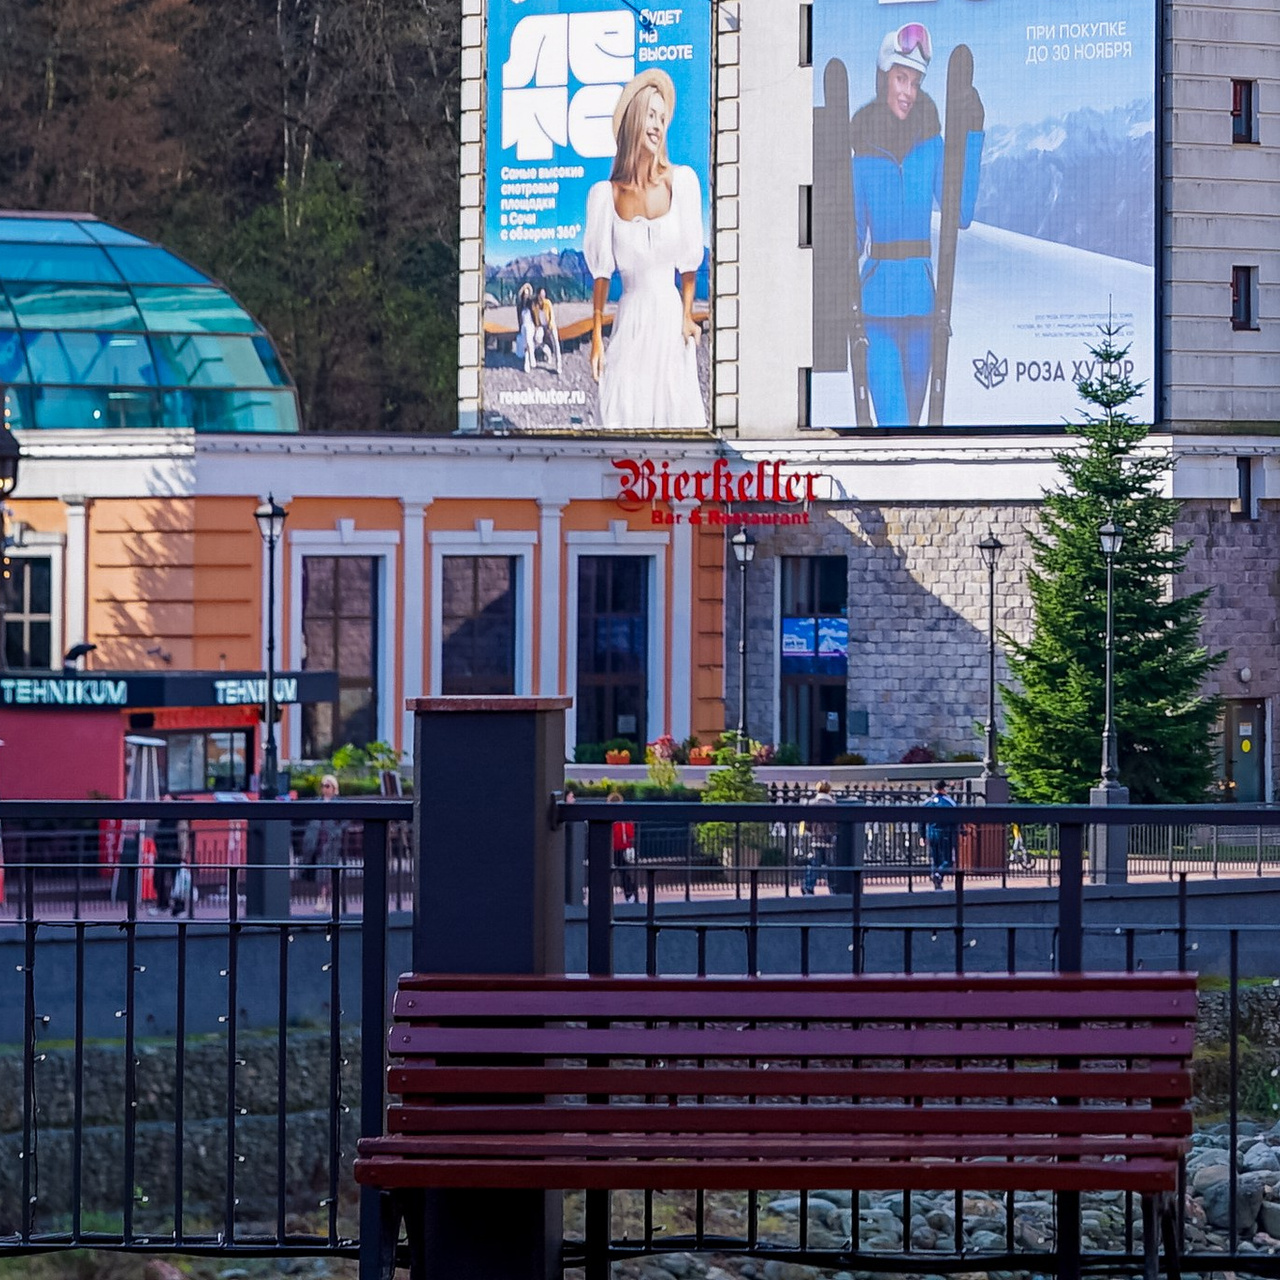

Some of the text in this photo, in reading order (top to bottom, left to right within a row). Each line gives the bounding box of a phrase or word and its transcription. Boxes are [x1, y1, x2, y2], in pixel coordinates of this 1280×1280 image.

[1026, 21, 1127, 40] ПРИ ПОКУПКЕ
[639, 44, 693, 62] ВЫСОТЕ
[1025, 41, 1132, 65] ДО 30 НОЯБРЯ
[1016, 360, 1065, 382] РОЗА
[499, 387, 586, 405] rosakhutor.ru
[611, 458, 823, 512] Bierkeller
[651, 508, 809, 525] Bar & Restaurant
[0, 678, 127, 705] TEHNIKUM
[214, 678, 298, 704] TEHNIUM
